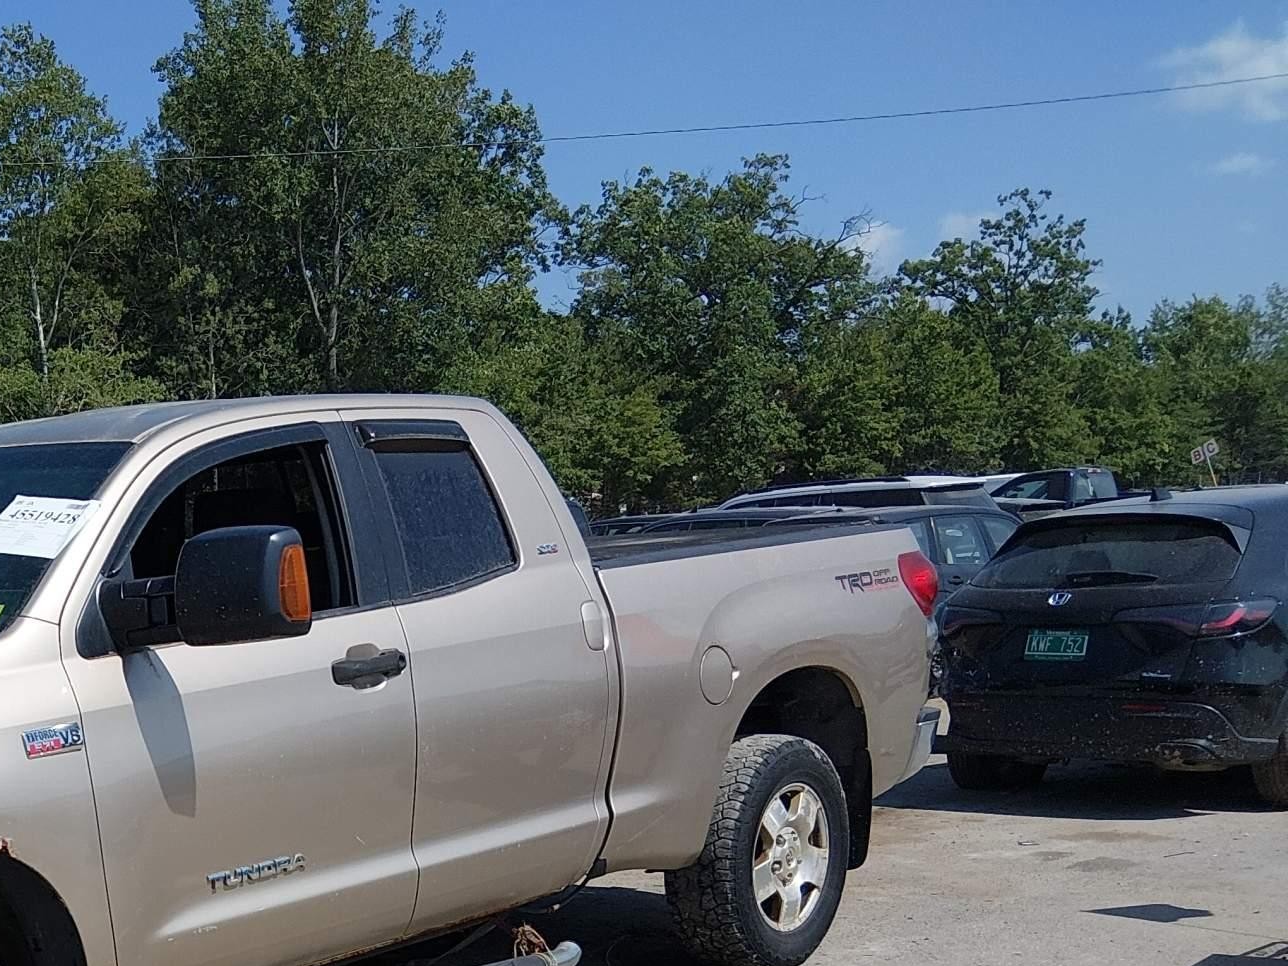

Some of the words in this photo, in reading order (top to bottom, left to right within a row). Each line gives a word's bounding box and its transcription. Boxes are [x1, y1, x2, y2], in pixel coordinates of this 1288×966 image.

[1193, 449, 1202, 461] B
[1206, 442, 1216, 454] C
[9, 509, 81, 525] 45519428
[835, 571, 873, 594] TRD
[1030, 636, 1054, 652] KWF
[1060, 636, 1082, 653] 752
[206, 853, 306, 895] TUNDRA
